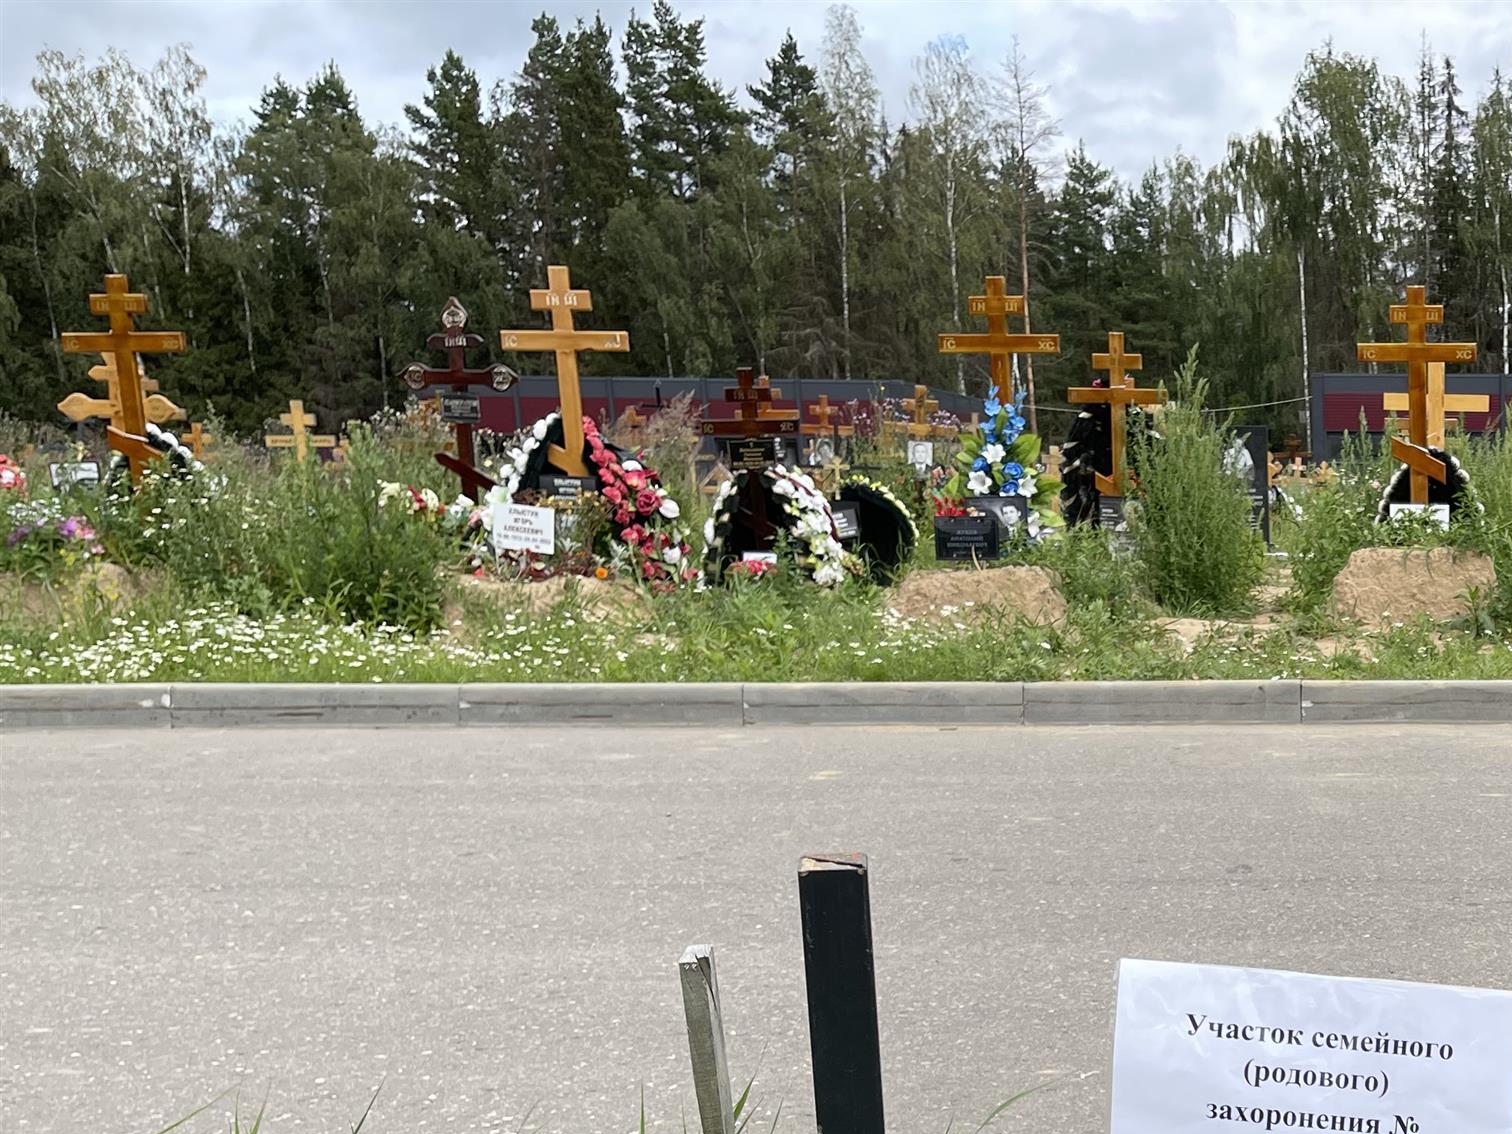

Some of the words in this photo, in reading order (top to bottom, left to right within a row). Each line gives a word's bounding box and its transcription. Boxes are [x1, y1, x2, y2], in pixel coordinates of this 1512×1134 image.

[503, 525, 544, 536] АЛЕКСЕЕВИЧ
[513, 518, 533, 526] ИГОРЬ
[1186, 1013, 1304, 1046] Участок
[1311, 1031, 1454, 1061] семейного
[1243, 1059, 1390, 1098] (родового)
[1206, 1103, 1381, 1134] захоронения
